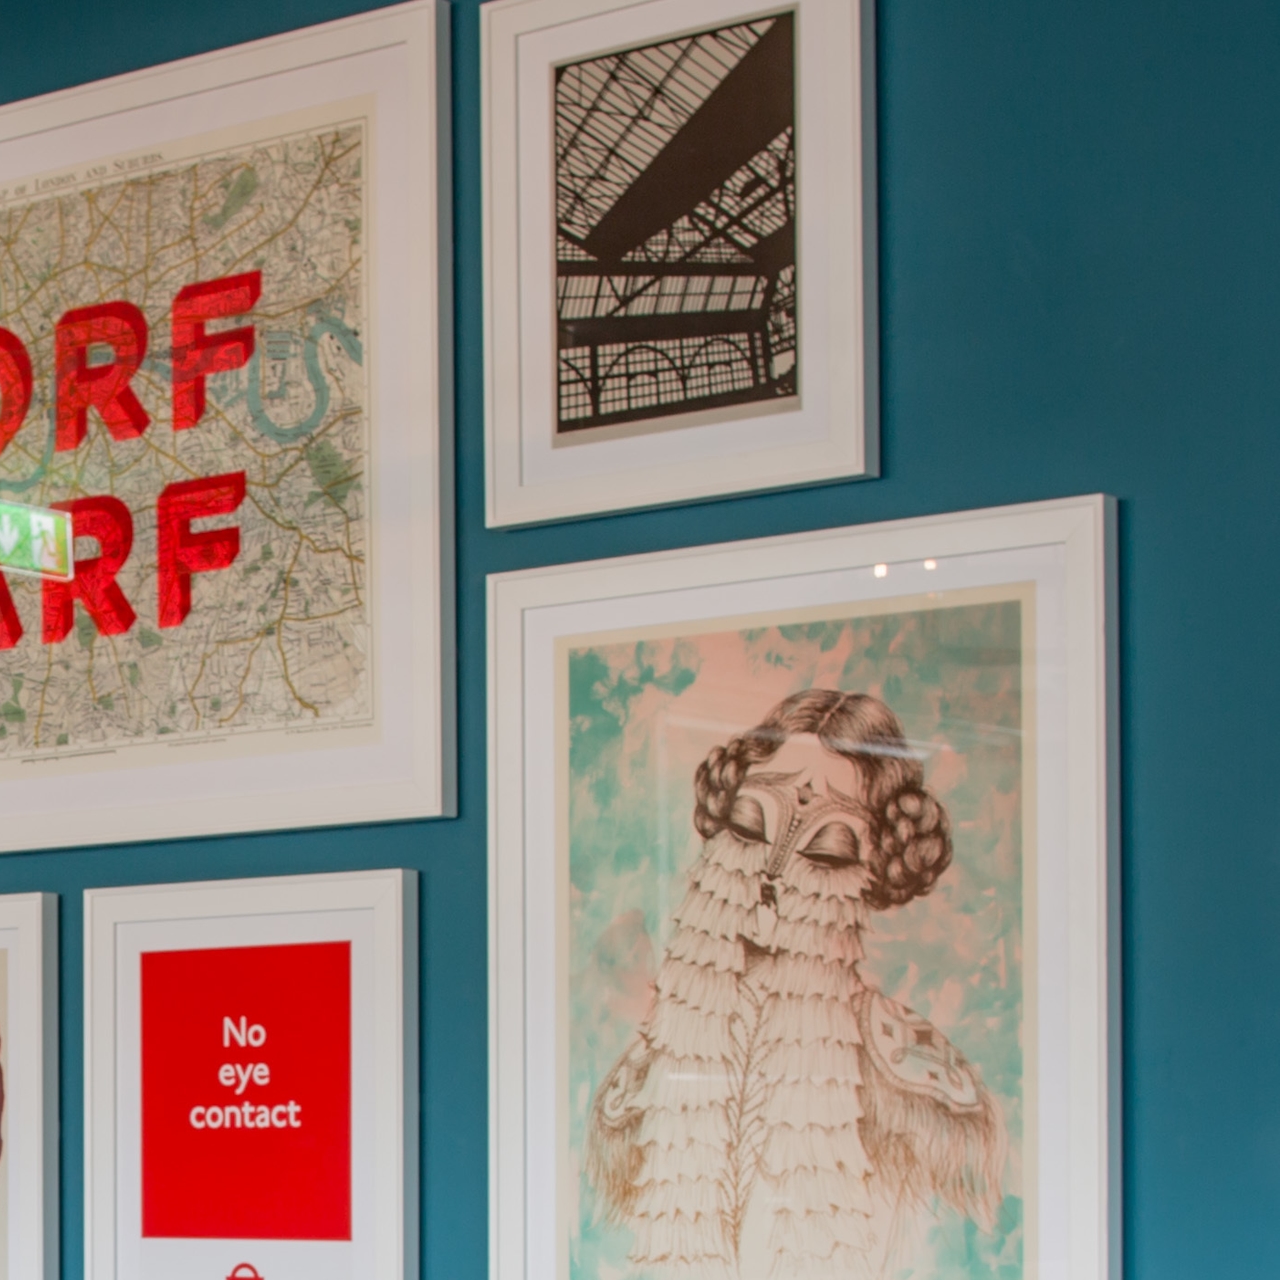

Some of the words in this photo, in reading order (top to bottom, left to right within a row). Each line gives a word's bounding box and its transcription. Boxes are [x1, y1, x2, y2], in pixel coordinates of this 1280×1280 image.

[223, 1016, 267, 1047] No
[218, 1062, 270, 1095] eye
[189, 1100, 301, 1129] contact
